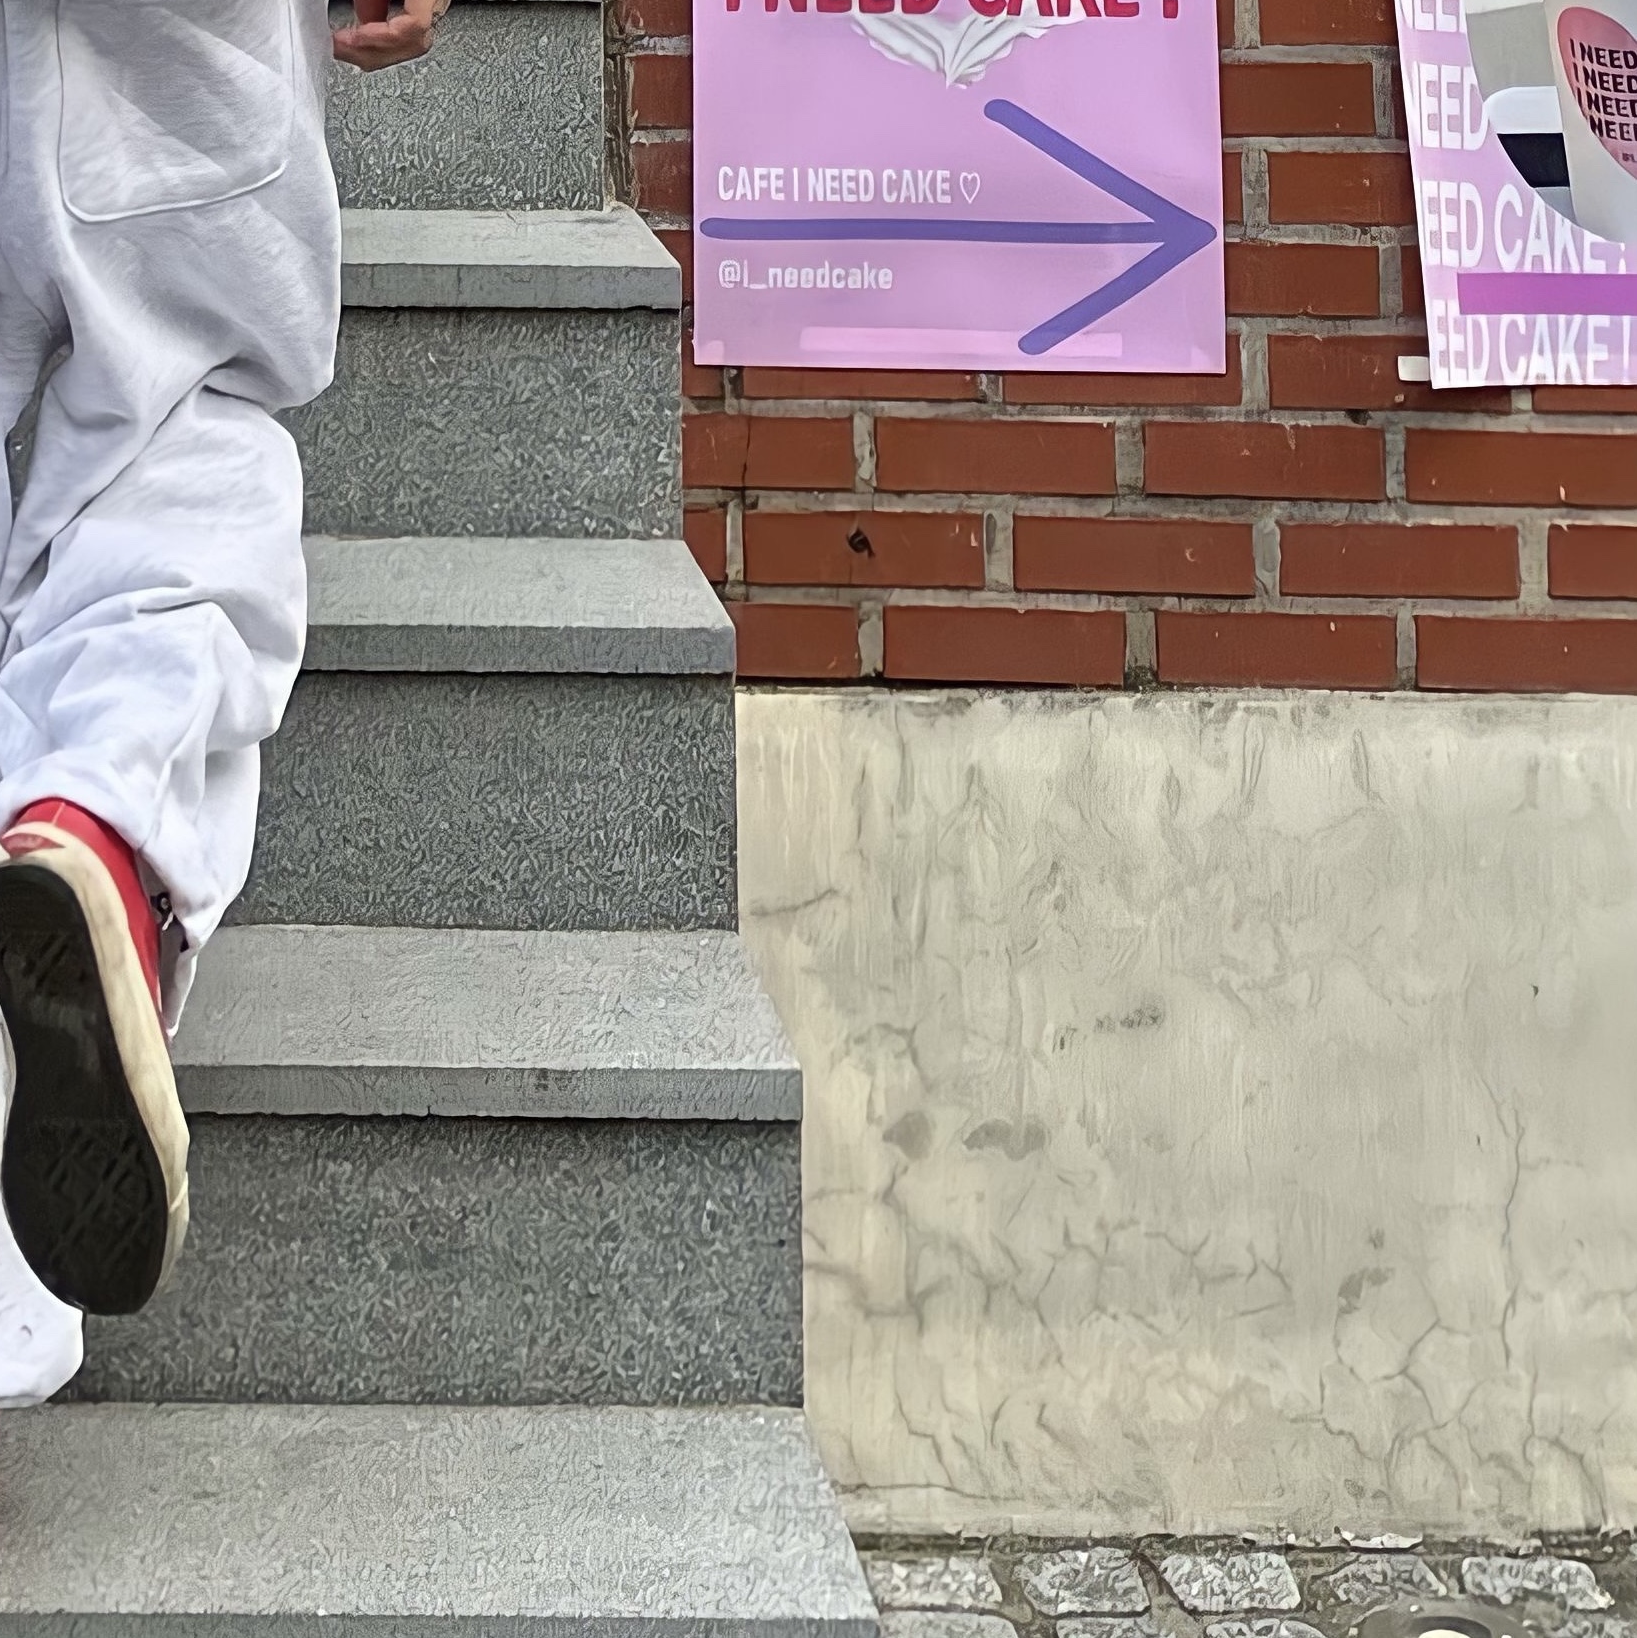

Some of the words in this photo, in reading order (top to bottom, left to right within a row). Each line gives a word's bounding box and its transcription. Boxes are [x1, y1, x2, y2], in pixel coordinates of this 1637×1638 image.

[718, 166, 785, 201] CAFE
[793, 167, 799, 201] I
[808, 168, 875, 202] NEED
[882, 169, 952, 204] CAKE
